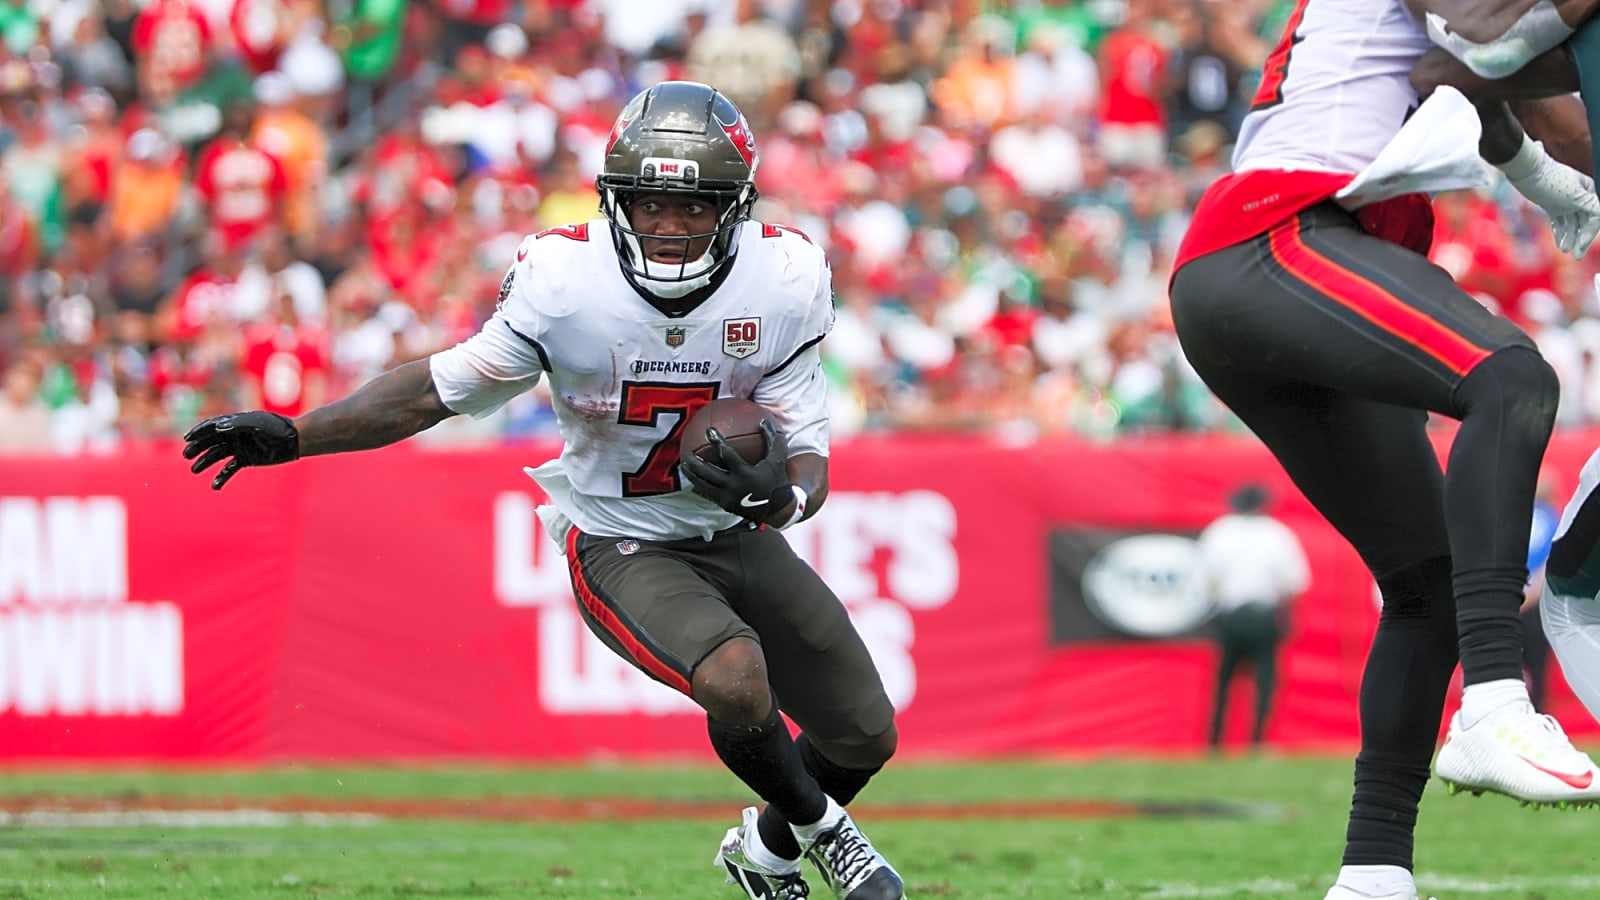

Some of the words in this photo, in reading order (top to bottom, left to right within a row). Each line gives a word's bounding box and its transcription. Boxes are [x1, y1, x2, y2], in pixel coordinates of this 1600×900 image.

[727, 322, 757, 343] 50
[635, 360, 711, 375] BUCCANEERS
[617, 380, 721, 497] 7
